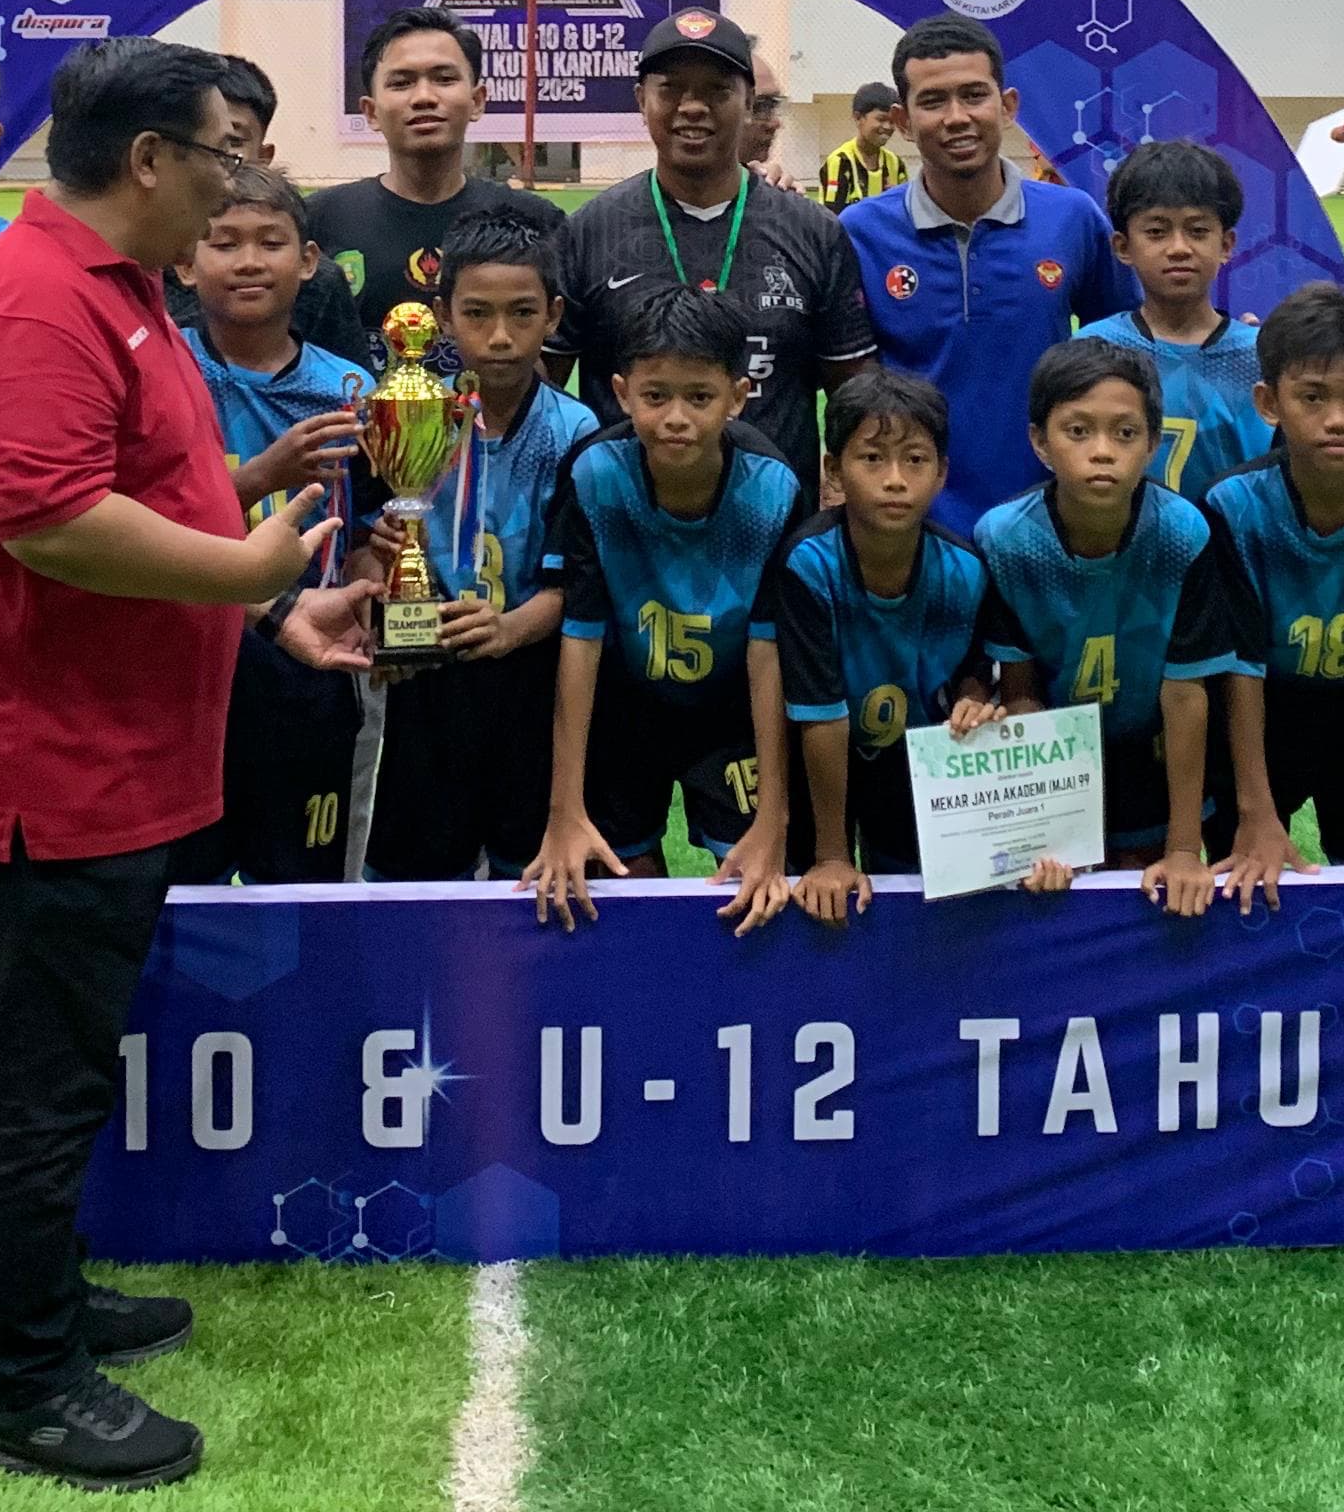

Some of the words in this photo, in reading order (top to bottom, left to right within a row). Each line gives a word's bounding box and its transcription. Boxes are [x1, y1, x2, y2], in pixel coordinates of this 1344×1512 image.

[962, 4, 990, 14] KUTAI
[563, 23, 579, 50] &
[582, 23, 625, 50] U-12
[481, 77, 527, 102] AHU
[537, 78, 586, 102] 2025
[1160, 415, 1198, 494] 7
[638, 600, 715, 683] 15
[1073, 635, 1121, 706] 4
[859, 683, 908, 747] 9
[945, 737, 1076, 779] SERTIFIKAT
[930, 793, 968, 812] MEKAR
[972, 789, 1000, 806] JAYA
[1003, 782, 1047, 801] AKADEMI
[1078, 773, 1090, 787] 99
[1016, 806, 1039, 817] Juara
[304, 792, 339, 849] 10
[361, 1028, 433, 1150] &
[539, 1021, 856, 1147] U-12
